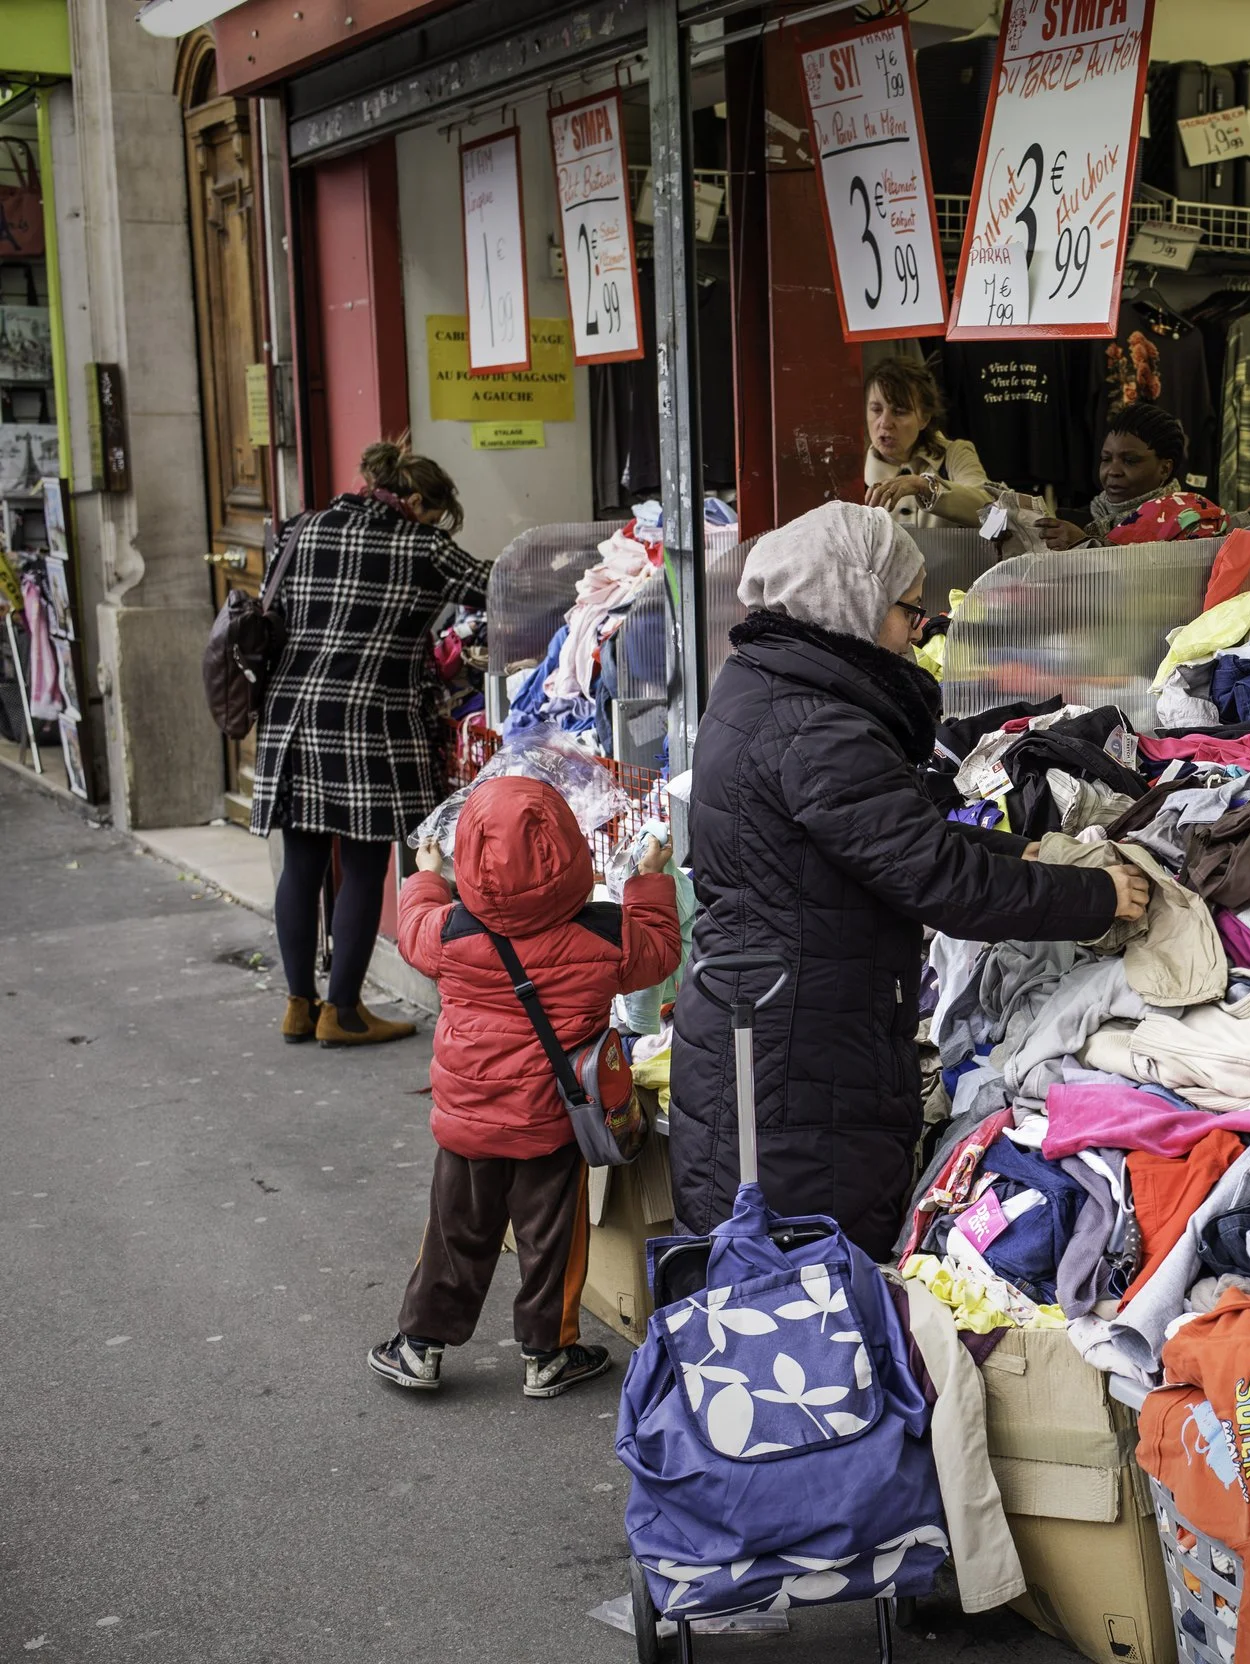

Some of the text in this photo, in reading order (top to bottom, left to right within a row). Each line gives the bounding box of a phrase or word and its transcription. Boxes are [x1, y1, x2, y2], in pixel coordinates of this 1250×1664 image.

[1041, 0, 1127, 41] SYMPA
[829, 45, 861, 92] SY
[850, 175, 883, 309] 3
[970, 247, 1012, 267] PARKA
[1049, 225, 1091, 299] 99
[578, 223, 599, 336] 2
[894, 244, 920, 305] 99
[603, 281, 621, 334] 99
[435, 331, 566, 345] CABI YAGE
[436, 371, 453, 381] AU
[512, 373, 567, 383] MAGASIN
[472, 391, 534, 402] A GAUCHE
